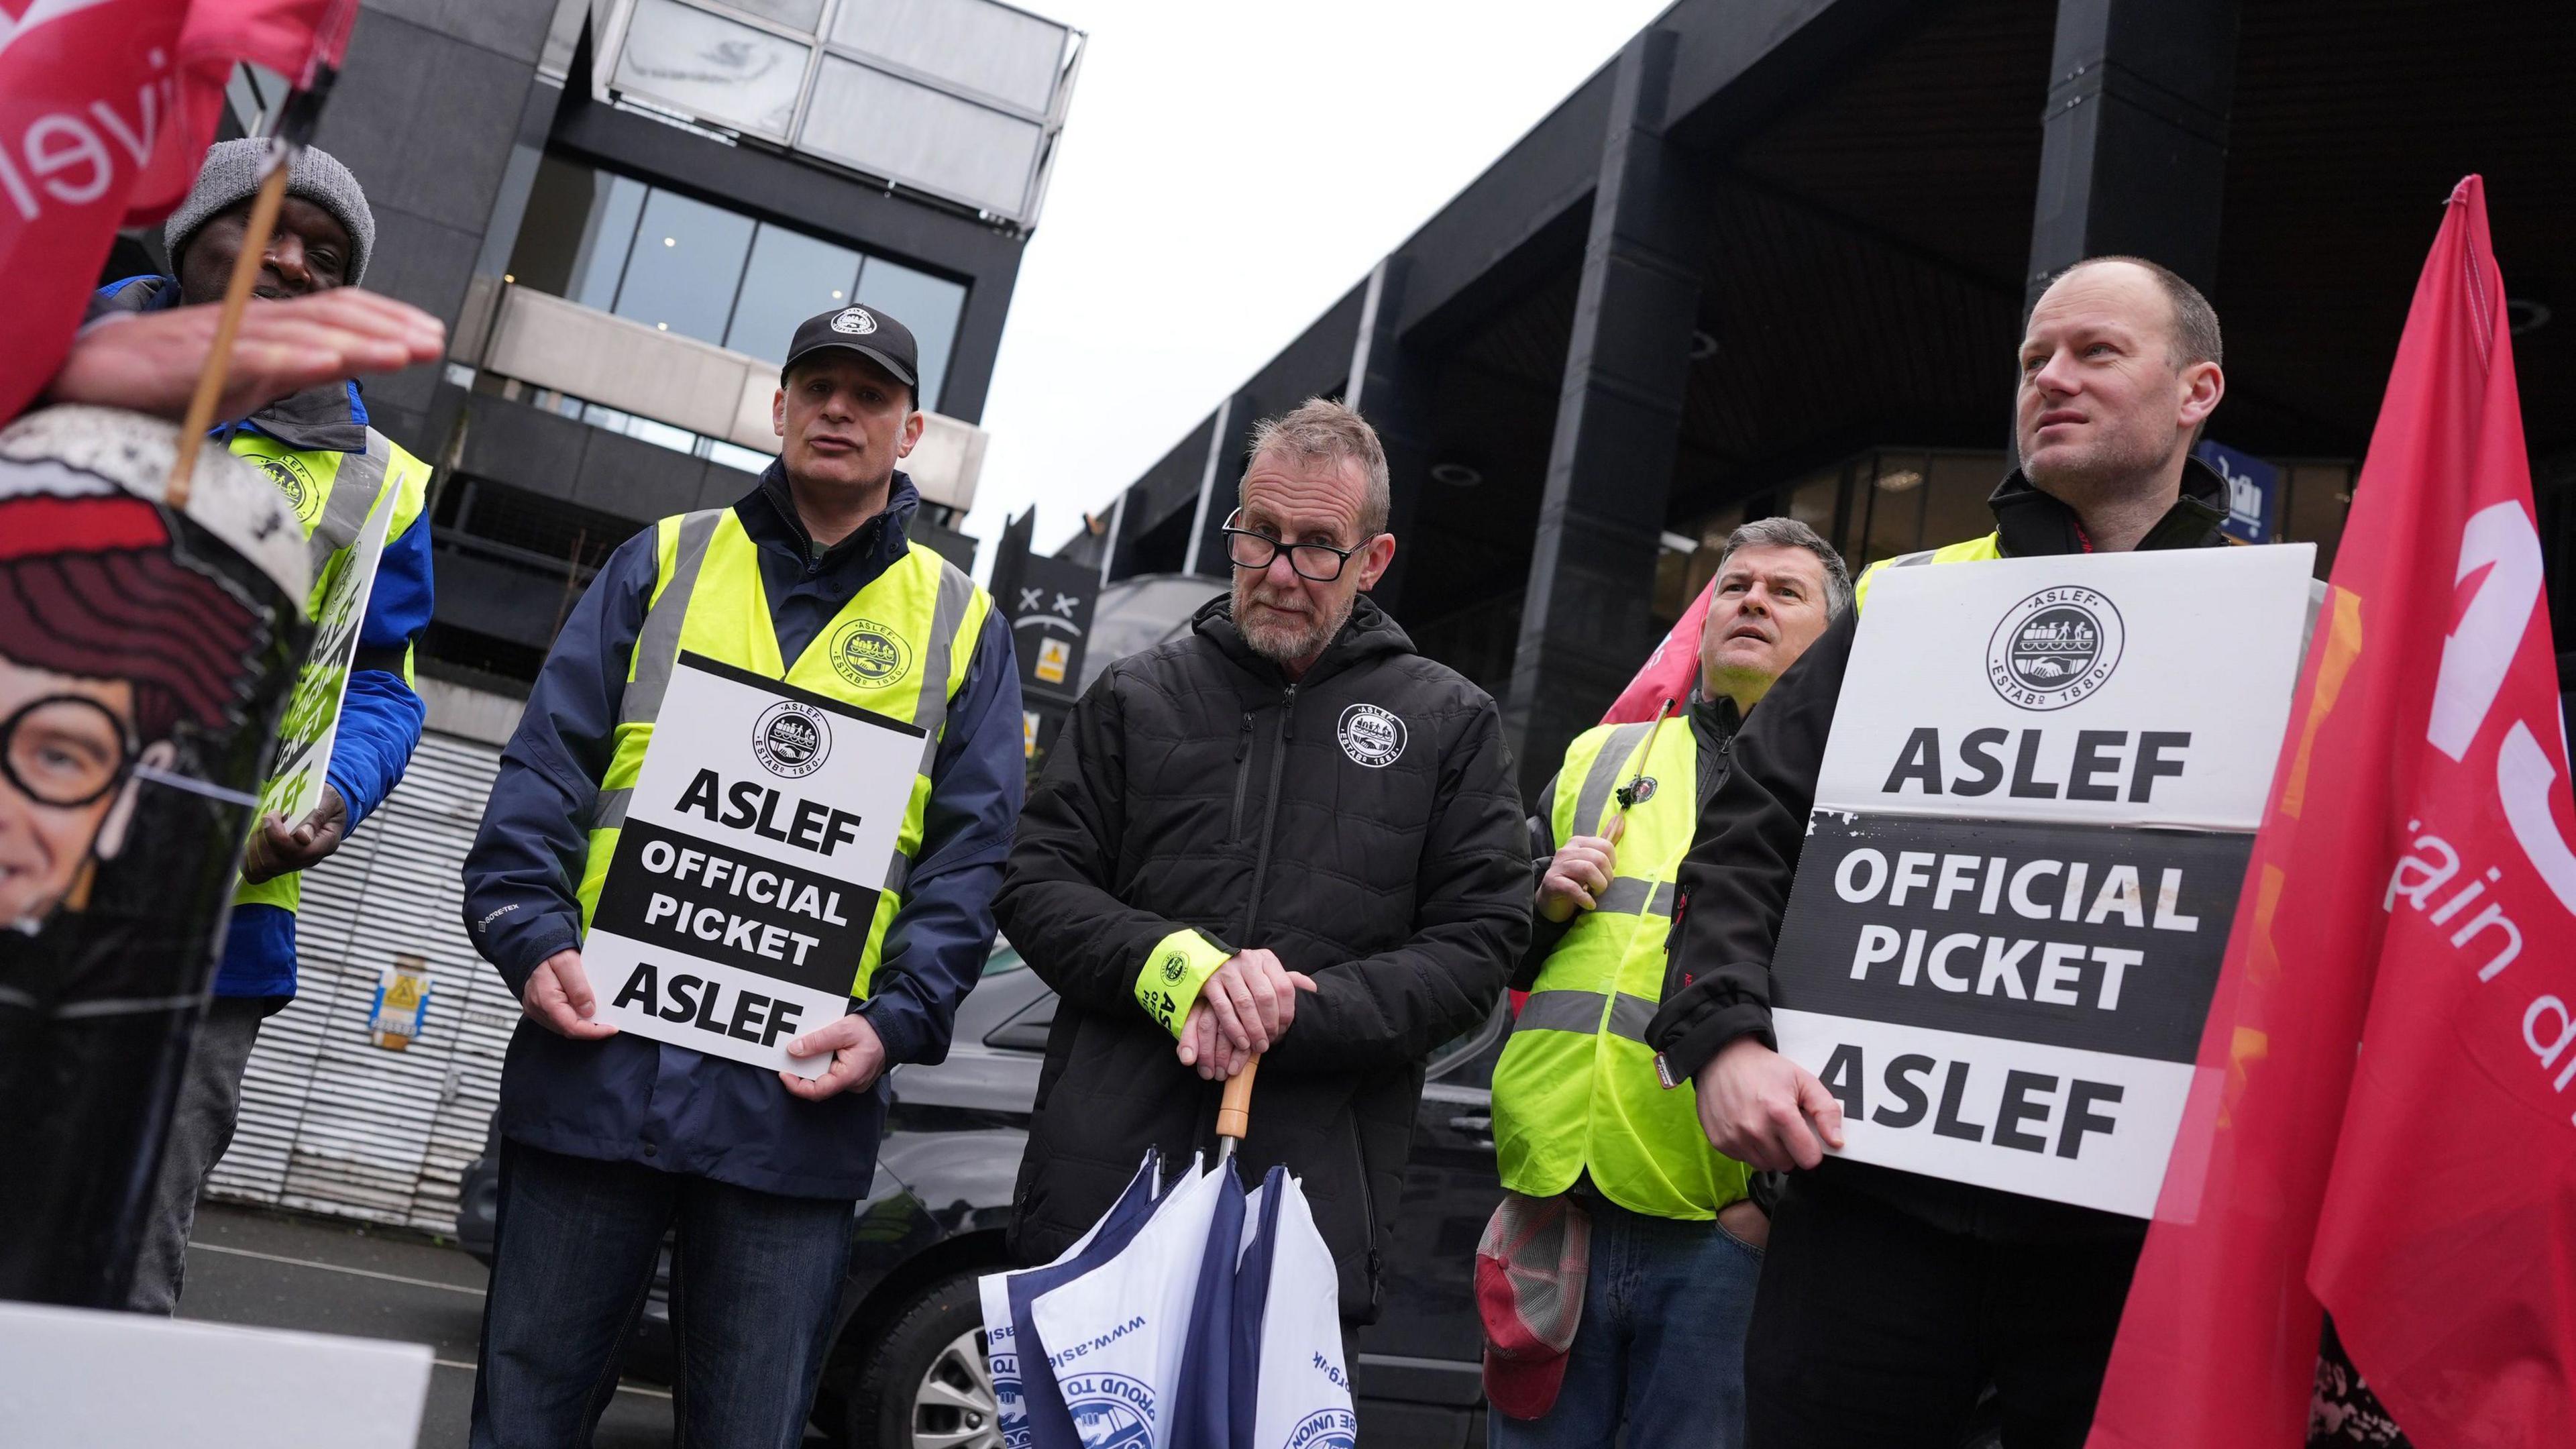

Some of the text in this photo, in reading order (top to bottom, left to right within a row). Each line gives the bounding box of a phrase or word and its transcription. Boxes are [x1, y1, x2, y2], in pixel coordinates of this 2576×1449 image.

[2034, 590, 2096, 608] ASLEF
[858, 621, 894, 637] ASLEF
[876, 670, 902, 686] 1880
[2061, 669, 2105, 702] 1880
[784, 704, 818, 718] ASLEF
[1360, 706, 1394, 721] ASLEF
[792, 760, 818, 775] 1880
[1374, 751, 1397, 765] 1880
[1882, 728, 2192, 804] ASLEF
[674, 768, 861, 857] ASLEF
[641, 840, 848, 926] OFFICIAL
[1834, 848, 2200, 932] OFFICIAL
[485, 904, 519, 924] GORE-TEX
[644, 893, 820, 967] PICKET
[1849, 925, 2143, 1011] PICKET
[612, 963, 804, 1048] ASLEF
[1817, 1044, 2125, 1161] ASLEF
[993, 1358, 1016, 1374] TO
[1067, 1379, 1097, 1396] TO
[1340, 1413, 1356, 1434] BE
